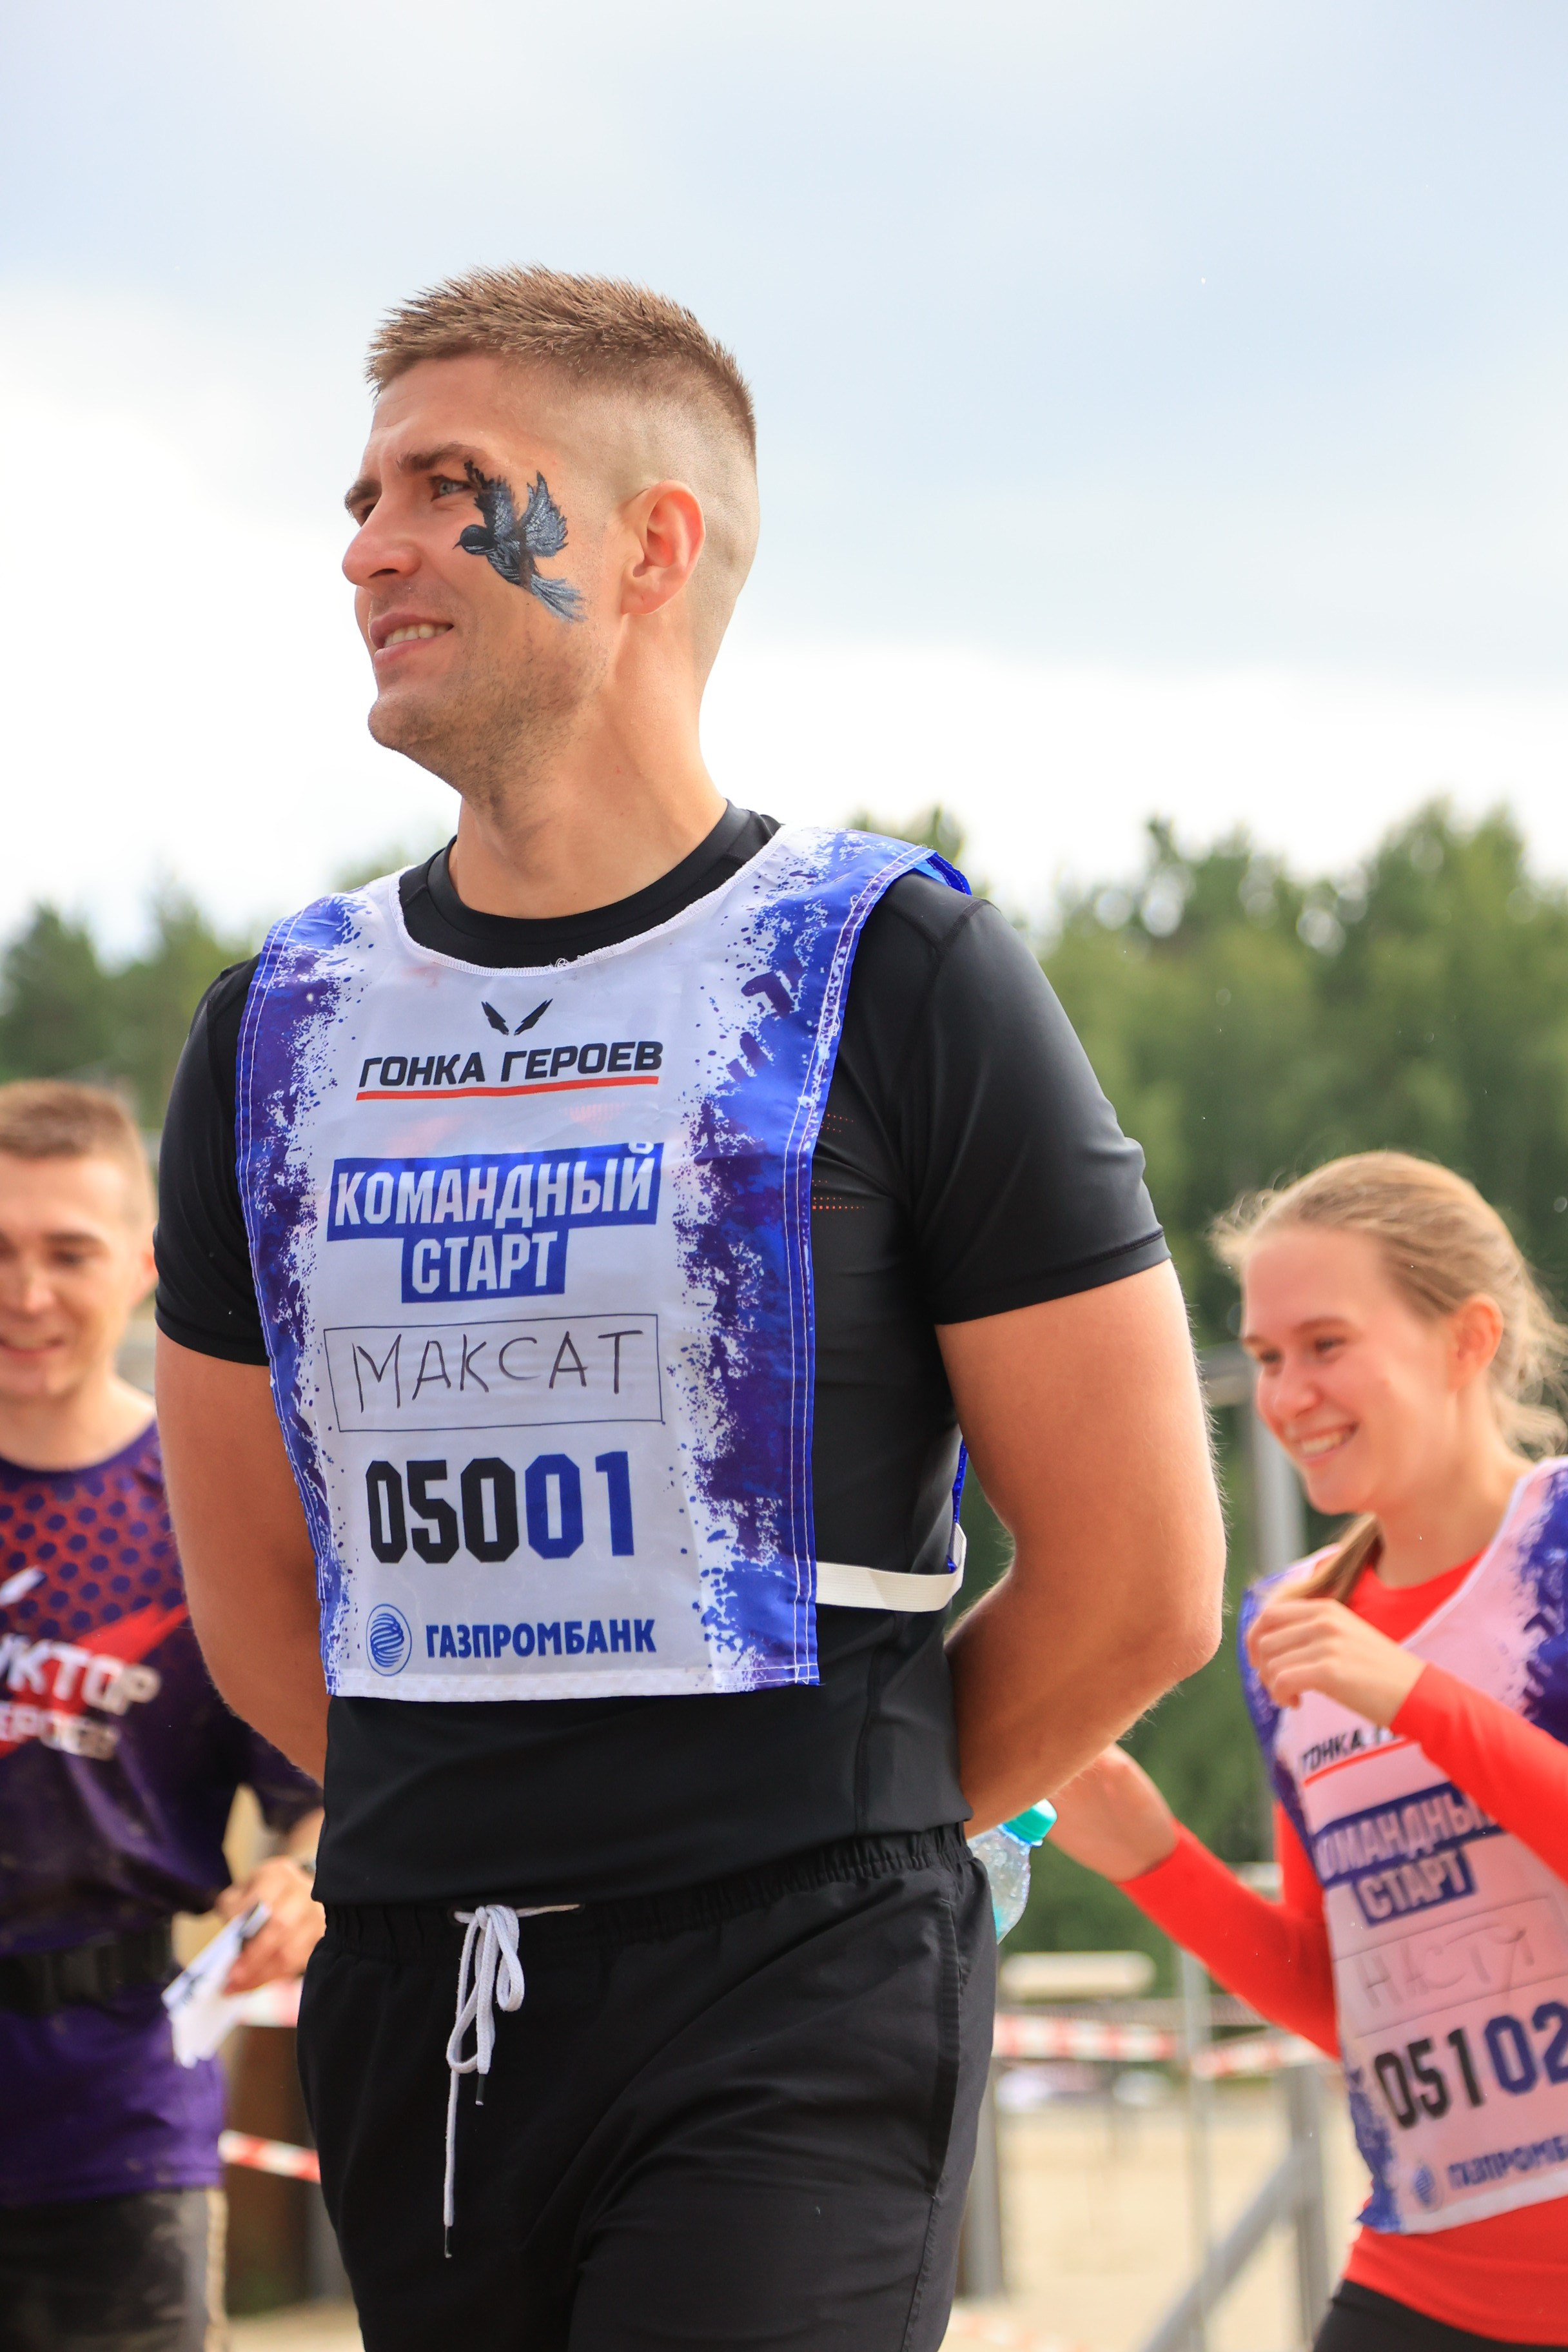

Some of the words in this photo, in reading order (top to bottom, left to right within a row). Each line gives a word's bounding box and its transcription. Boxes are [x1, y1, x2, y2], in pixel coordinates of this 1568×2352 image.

[359, 1052, 485, 1088] ГОНКА
[500, 1041, 663, 1083] ГЕРОЕВ
[334, 1141, 656, 1230] КОМАНДНЫЙ
[411, 1231, 558, 1295] СТАРТ
[351, 1330, 644, 1413] МАКСАТ
[366, 1451, 635, 1563] 05001
[426, 1619, 657, 1659] ГАЗПРОМБАНК
[1357, 1849, 1466, 1919] СТАРТ
[1374, 2002, 1568, 2128] 05102
